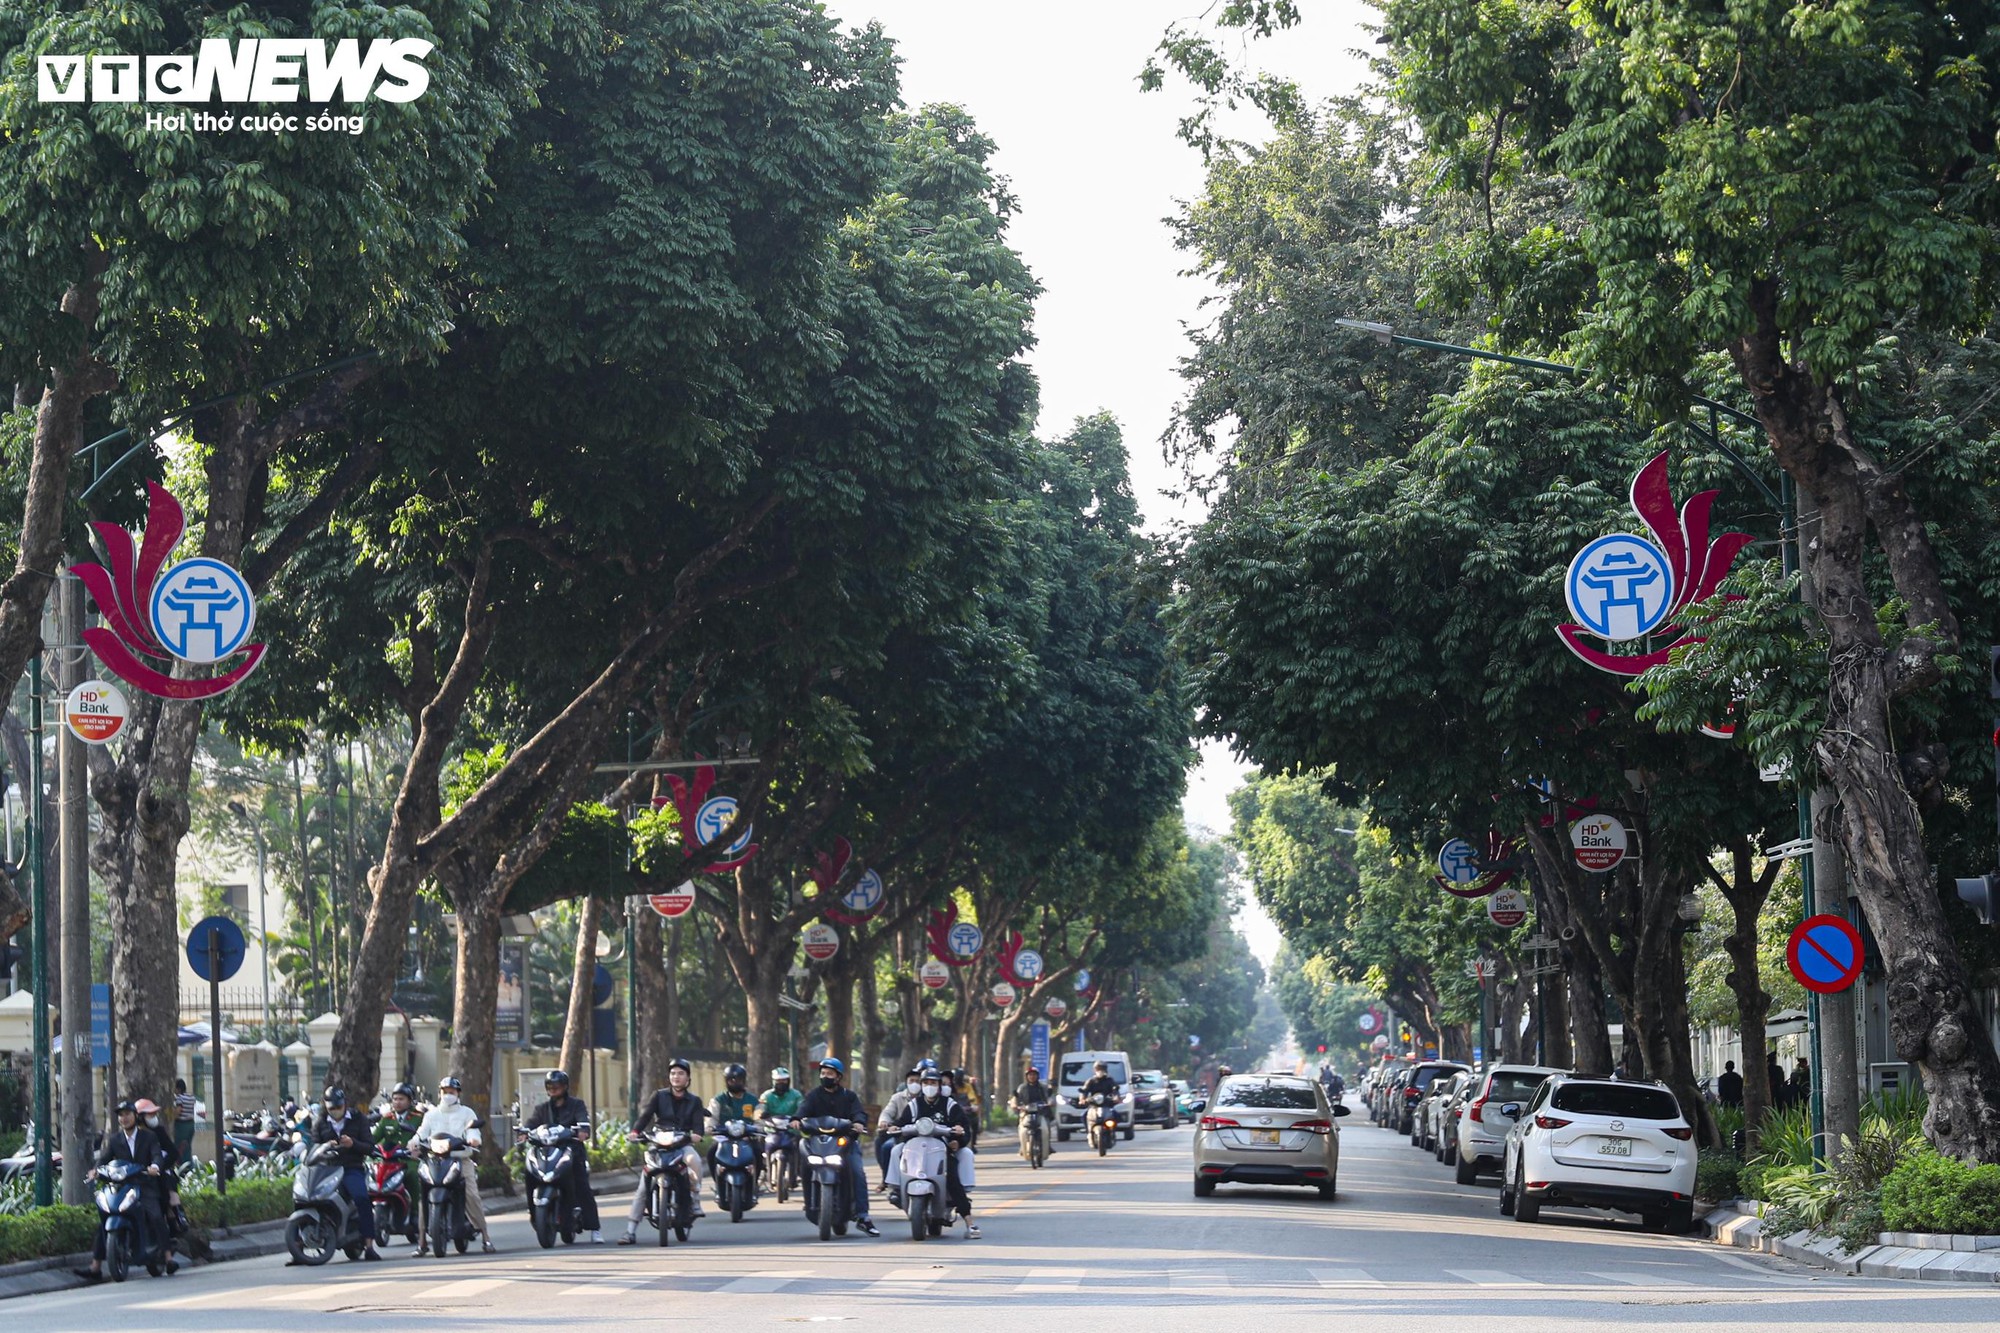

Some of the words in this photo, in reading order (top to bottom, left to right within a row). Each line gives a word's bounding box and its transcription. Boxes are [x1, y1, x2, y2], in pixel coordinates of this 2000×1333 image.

[80, 691, 97, 702] HD
[80, 702, 109, 713] Bank
[1581, 825, 1599, 835] HD
[1581, 836, 1612, 846] Bank
[1496, 895, 1508, 903] HD
[1496, 902, 1517, 910] Bank
